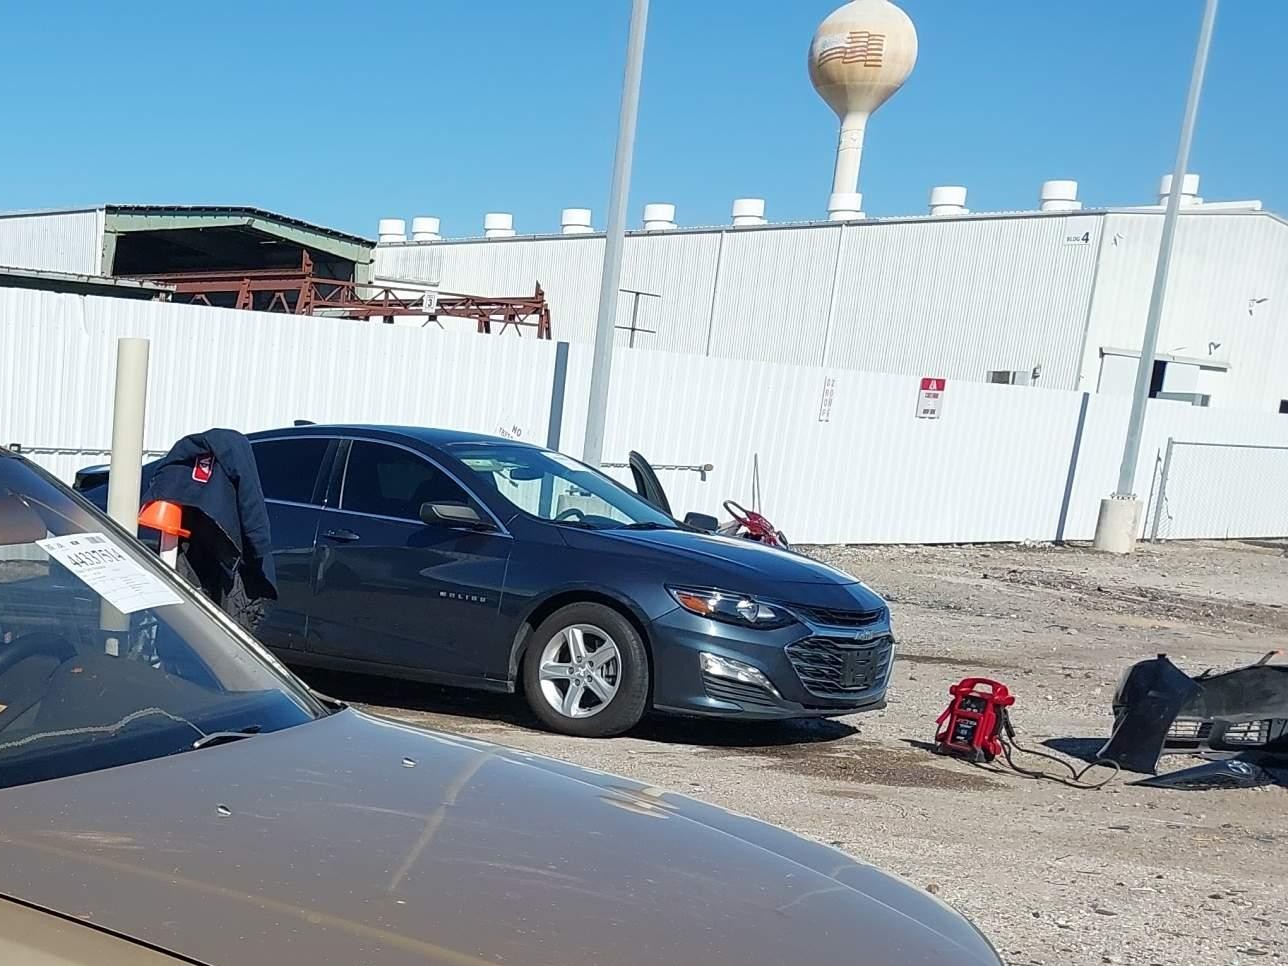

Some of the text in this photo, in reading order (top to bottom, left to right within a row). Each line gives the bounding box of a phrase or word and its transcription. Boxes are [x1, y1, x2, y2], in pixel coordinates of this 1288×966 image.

[1081, 232, 1090, 243] 4
[511, 424, 522, 437] NO
[67, 547, 126, 567] 44337514
